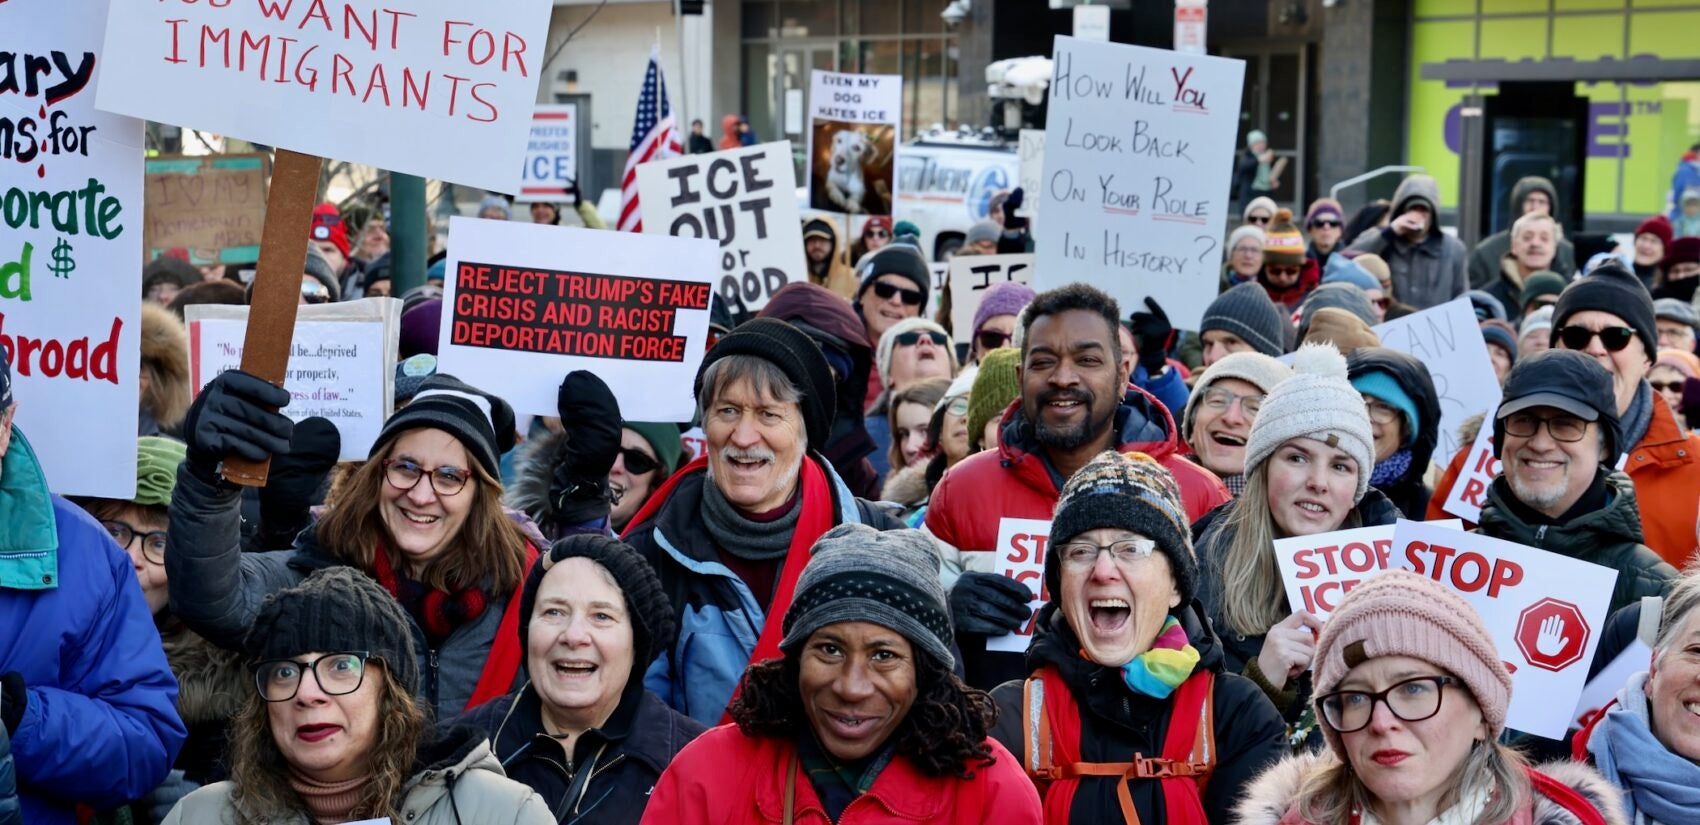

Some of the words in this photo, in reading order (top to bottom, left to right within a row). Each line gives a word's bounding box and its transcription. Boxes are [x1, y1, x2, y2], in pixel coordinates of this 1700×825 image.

[258, 0, 417, 50] WANT
[443, 20, 528, 77] FOR
[164, 19, 499, 122] IMMIGRANTS
[822, 74, 853, 87] EVEN
[858, 78, 880, 88] MY
[818, 106, 857, 119] HATES
[862, 110, 887, 121] ICE
[833, 92, 862, 103] DOG
[47, 110, 97, 157] for
[522, 155, 569, 181] ICE
[667, 152, 774, 208] ICE
[0, 178, 123, 240] orate
[669, 197, 772, 248] OUT
[459, 265, 549, 295] REJECT
[555, 274, 654, 304] TRUMP'S
[659, 283, 710, 308] FAKE
[456, 293, 537, 322] CRISIS
[542, 302, 592, 327] AND
[598, 306, 673, 333] RACIST
[453, 320, 610, 357] DEPORTATION
[620, 334, 685, 361] FORCE
[1293, 539, 1393, 580] STOP
[1402, 540, 1524, 598] STOP
